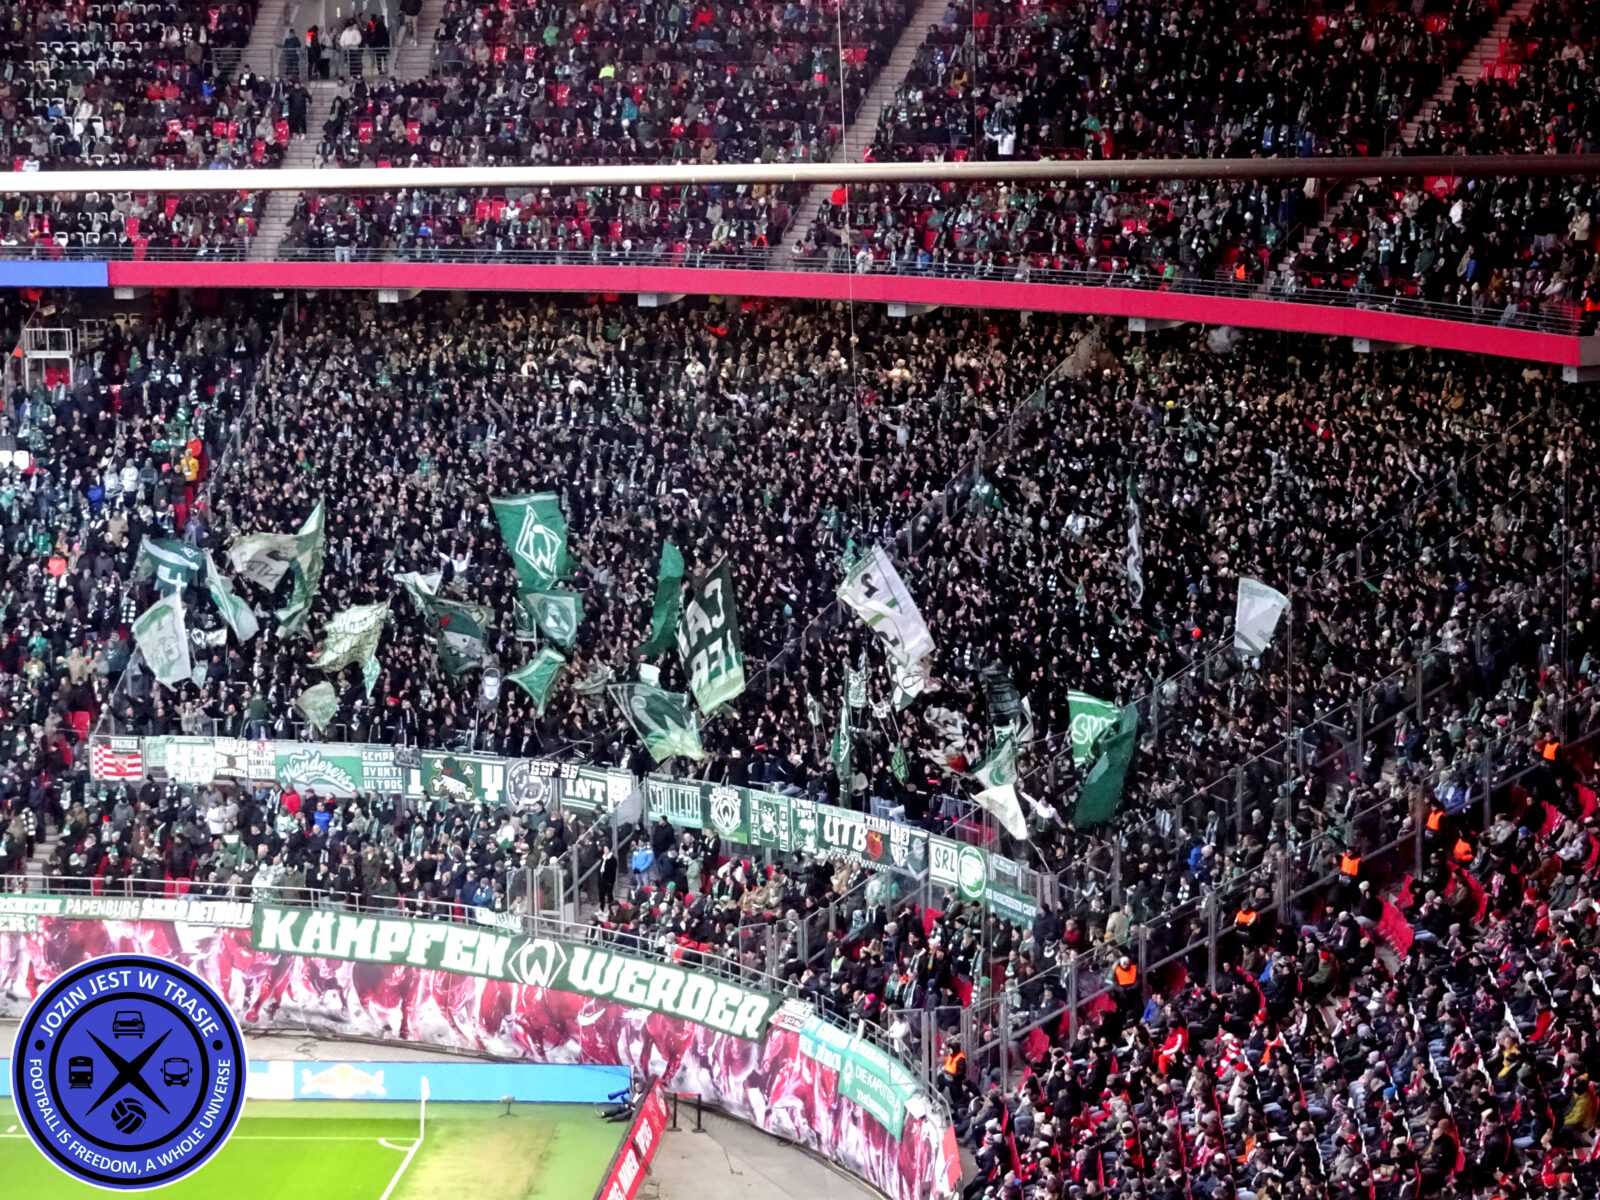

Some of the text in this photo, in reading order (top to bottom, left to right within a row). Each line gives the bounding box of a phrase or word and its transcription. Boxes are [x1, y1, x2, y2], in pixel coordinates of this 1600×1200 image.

[362, 751, 395, 762] SEMPR
[279, 751, 354, 786] Wanderers
[363, 766, 402, 777] AVANTI
[529, 761, 559, 778] GSF
[364, 779, 403, 790] ULTRAS
[823, 815, 868, 853] UTB
[934, 850, 956, 875] SRL
[65, 898, 140, 917] PAPENBURG
[258, 907, 512, 978] KÄMPFEN
[567, 946, 770, 1039] WERDER
